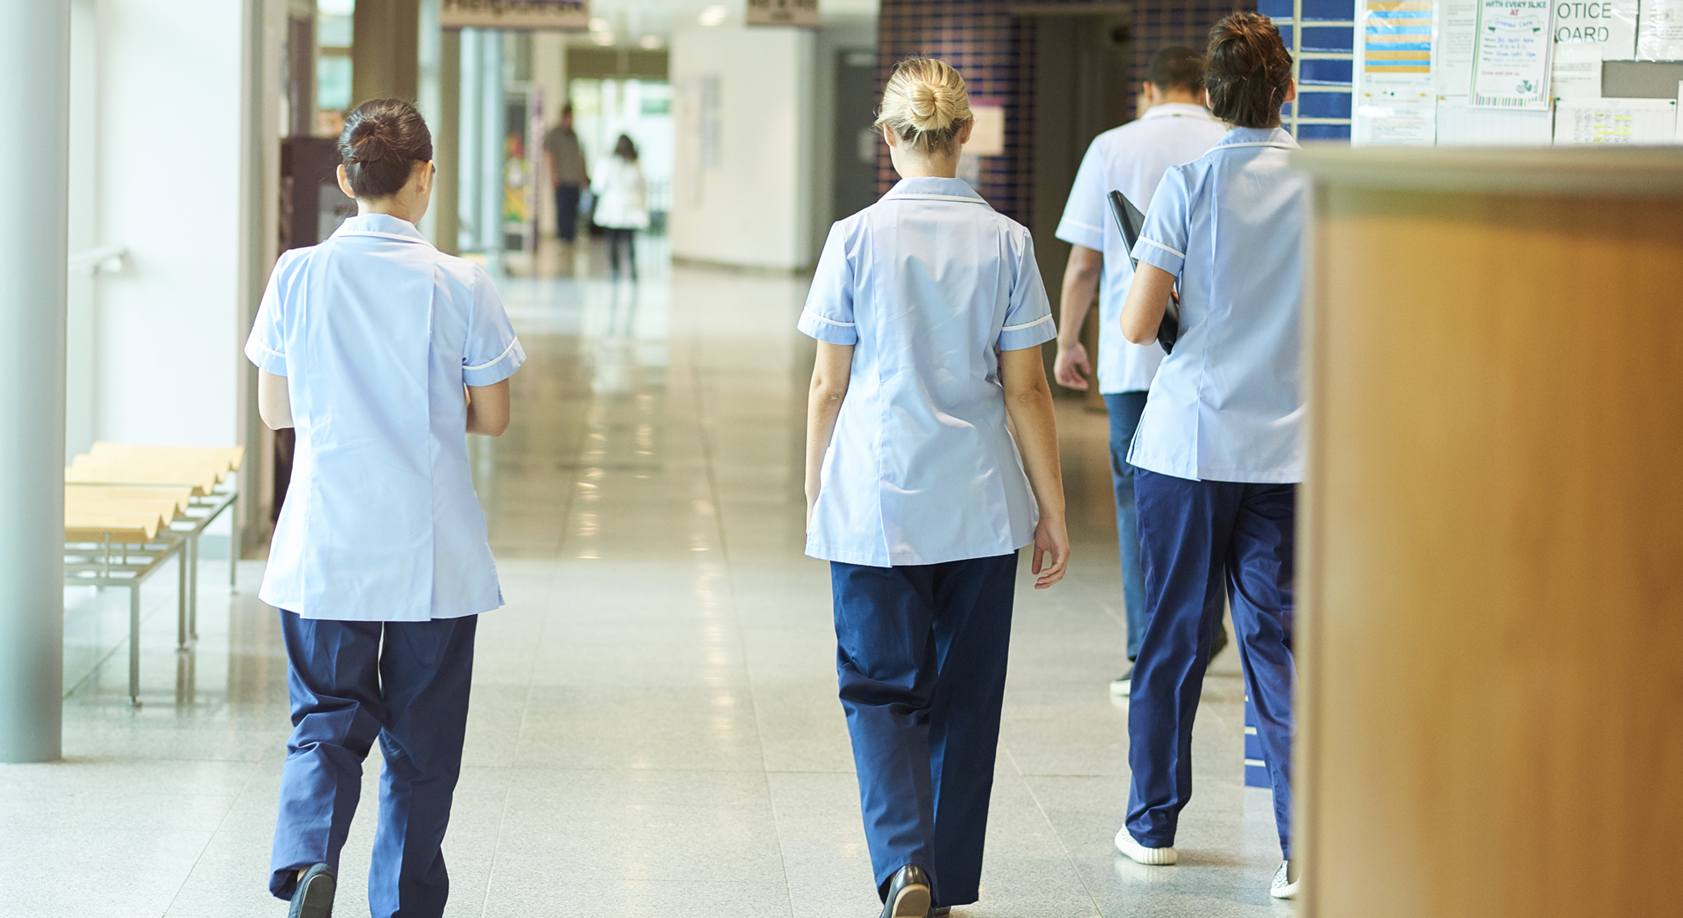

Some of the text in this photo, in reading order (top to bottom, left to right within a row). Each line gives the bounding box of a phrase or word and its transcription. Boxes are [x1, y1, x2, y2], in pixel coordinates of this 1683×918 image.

[1485, 0, 1503, 8] WITH
[1557, 2, 1611, 19] OTICE
[1557, 26, 1609, 42] OARD
